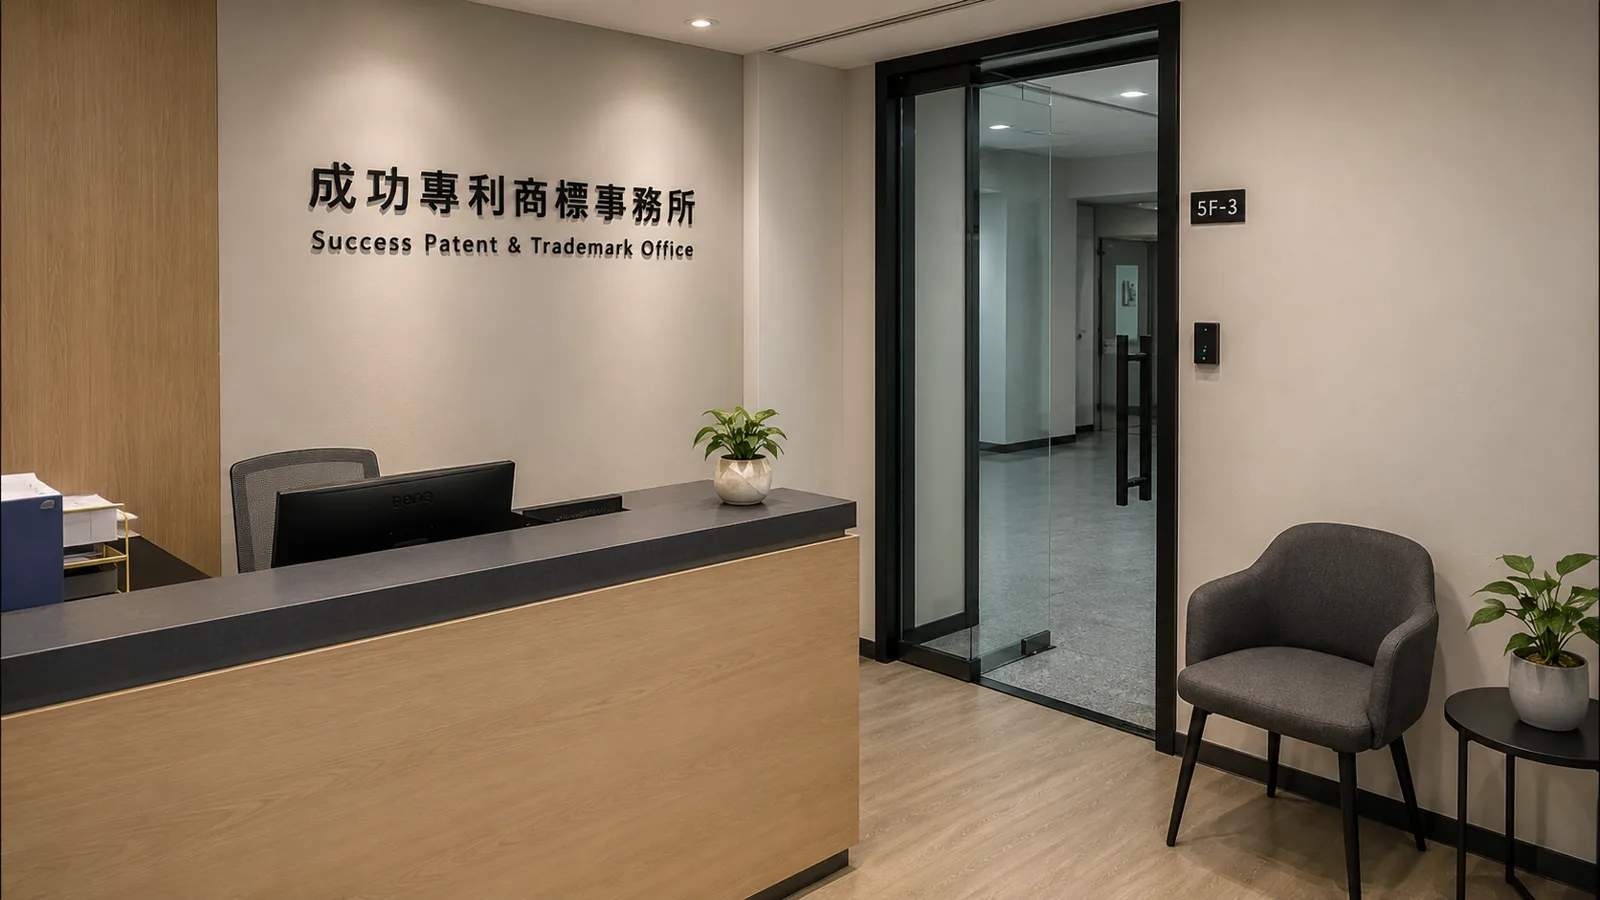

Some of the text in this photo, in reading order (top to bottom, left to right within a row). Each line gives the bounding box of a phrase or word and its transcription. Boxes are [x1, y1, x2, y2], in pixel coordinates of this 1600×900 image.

[308, 161, 696, 225] 成功專利商標事務所
[1197, 198, 1238, 217] 5F-3
[311, 229, 694, 258] Success Patent & Trademark Office
